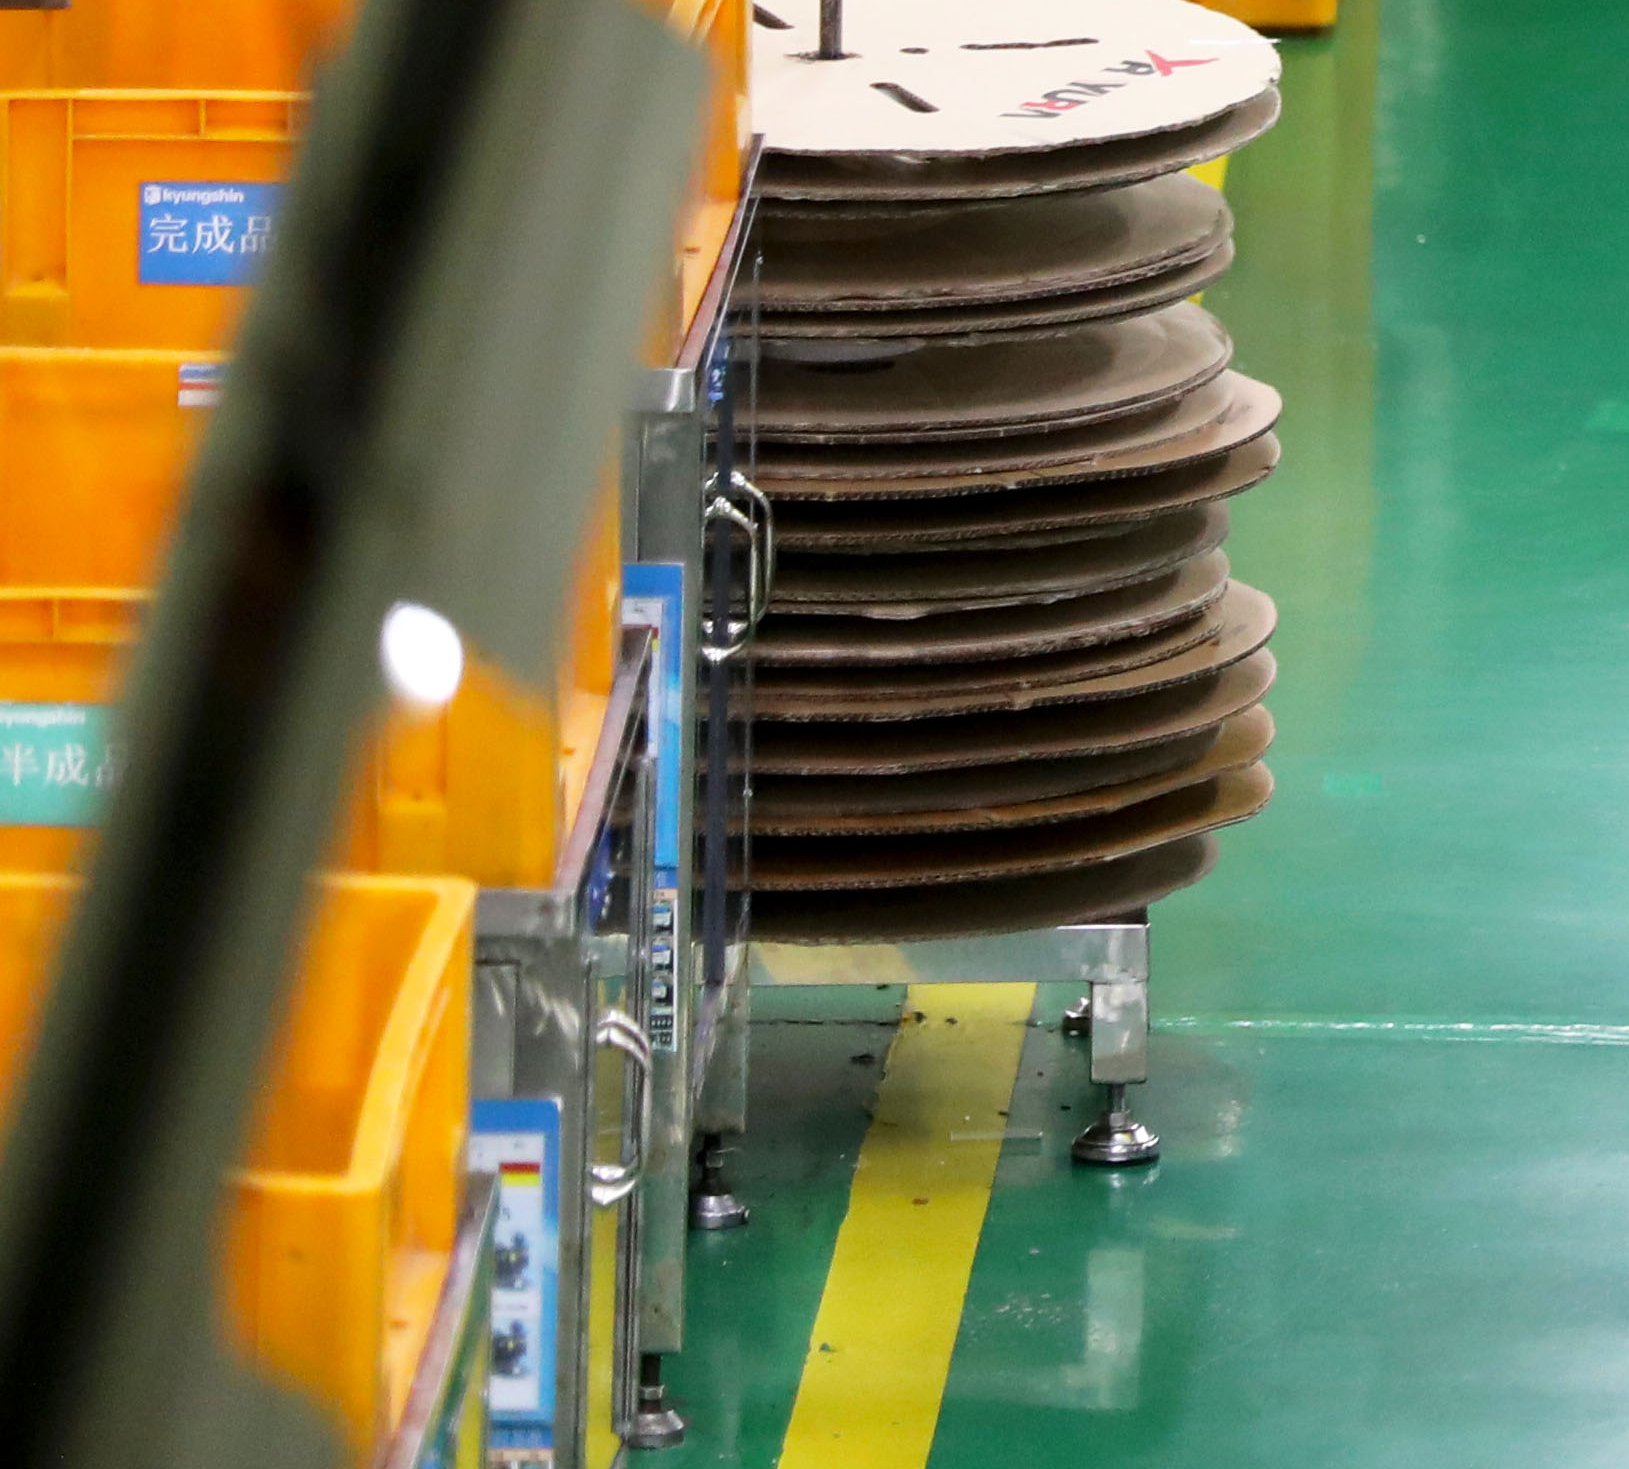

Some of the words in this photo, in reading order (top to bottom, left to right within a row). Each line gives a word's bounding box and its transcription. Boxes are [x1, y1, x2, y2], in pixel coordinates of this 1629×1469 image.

[162, 188, 245, 206] kyungshin
[147, 213, 274, 254] 完成品
